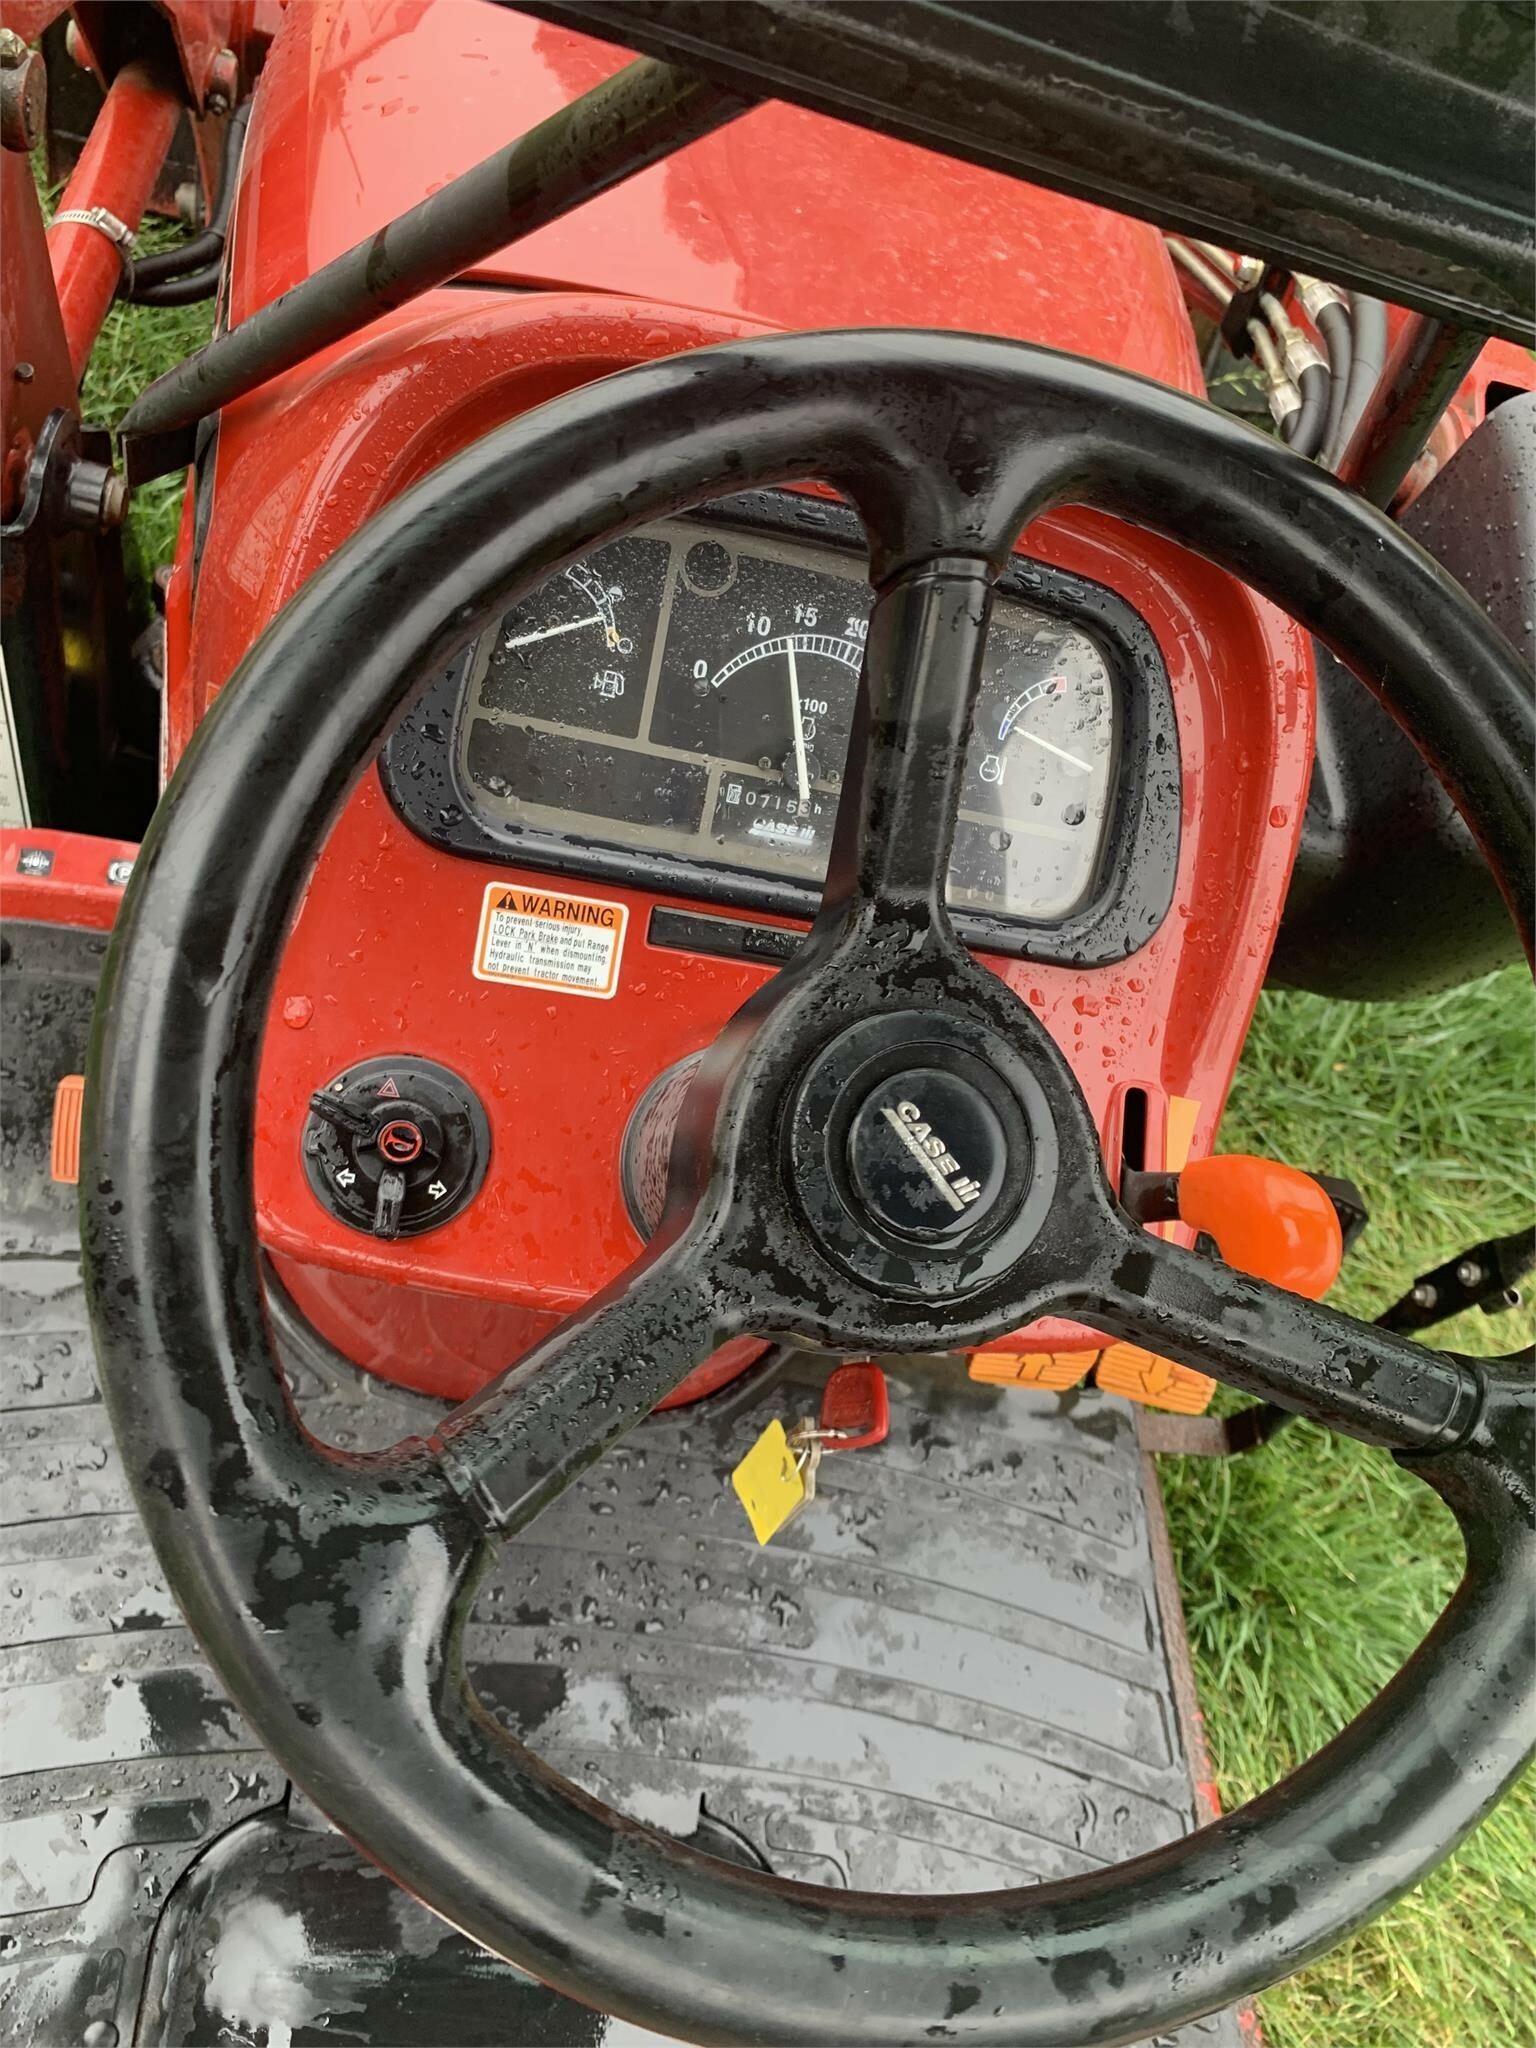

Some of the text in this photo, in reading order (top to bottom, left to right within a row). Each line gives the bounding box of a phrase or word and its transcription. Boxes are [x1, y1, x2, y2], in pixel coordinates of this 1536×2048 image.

[693, 659, 708, 679] 0
[753, 818, 799, 836] CASE
[522, 894, 615, 928] WARNING
[496, 912, 505, 922] To
[505, 915, 533, 927] prevent
[535, 919, 561, 932] serious
[491, 936, 512, 949] Lever
[515, 939, 522, 950] in
[540, 945, 560, 957] when
[493, 923, 610, 954] LOCK Park Brake and put Range
[487, 961, 499, 971] not
[502, 963, 531, 976] prevent
[534, 966, 560, 980] tractor
[489, 949, 592, 975] Hydraulic transmission may
[896, 1100, 961, 1177] CASE
